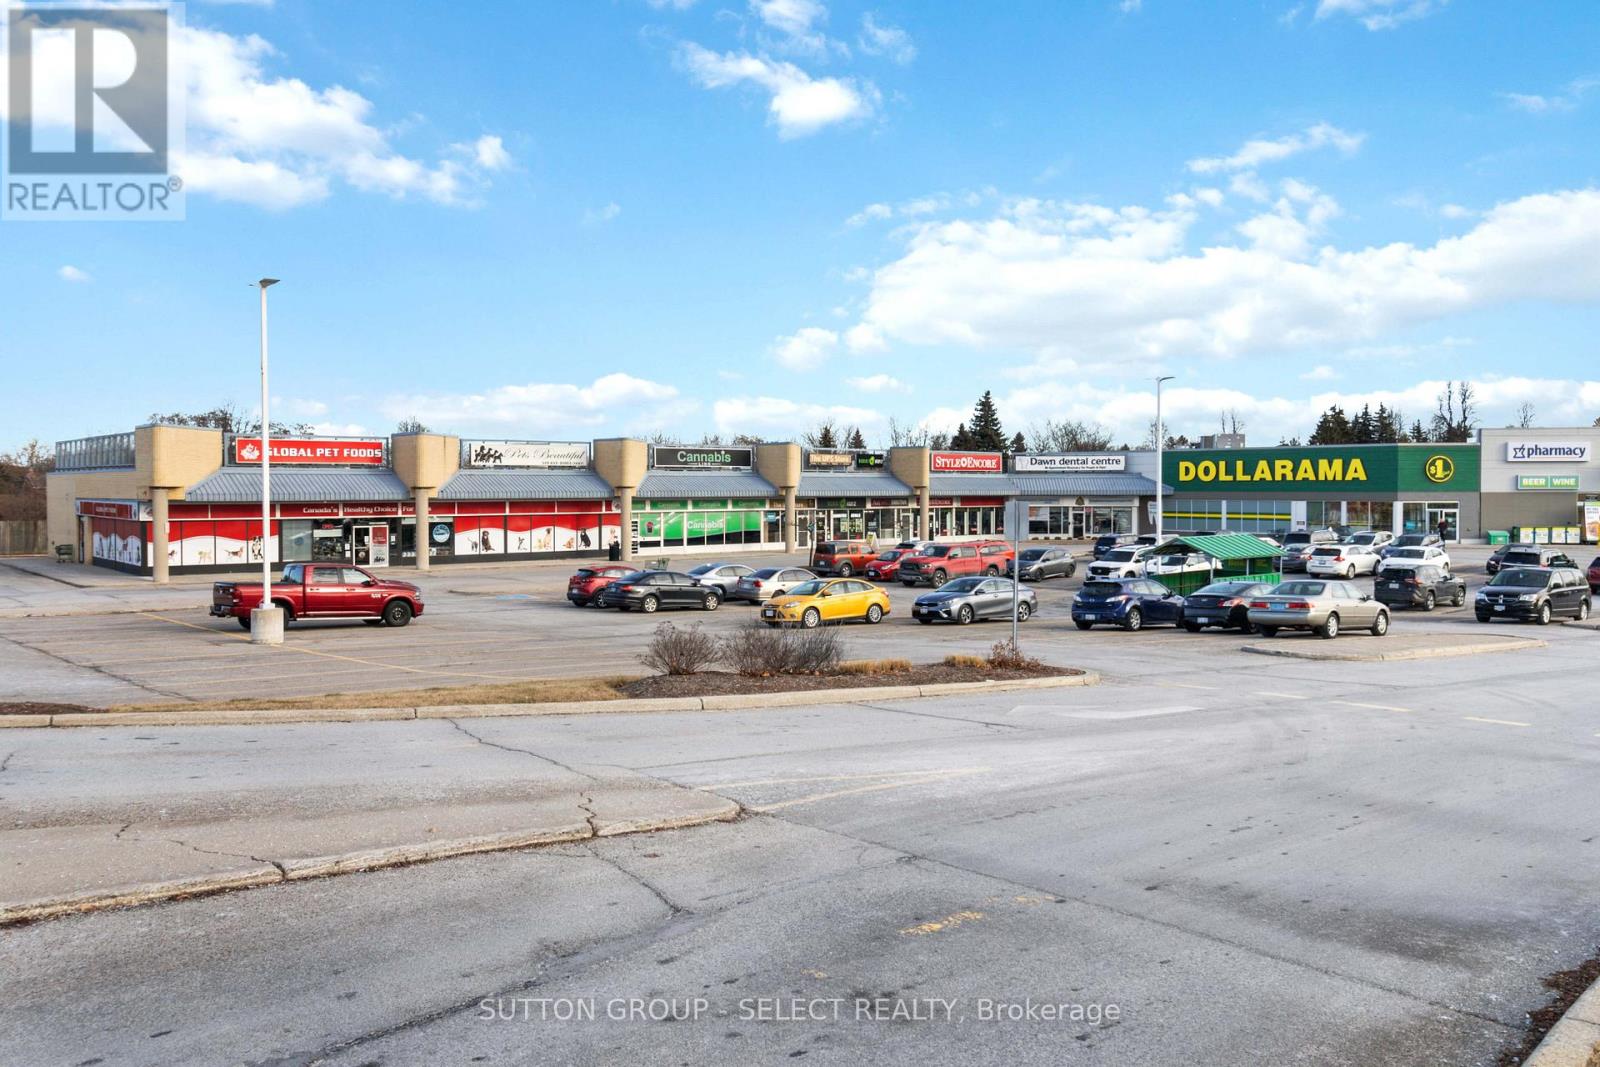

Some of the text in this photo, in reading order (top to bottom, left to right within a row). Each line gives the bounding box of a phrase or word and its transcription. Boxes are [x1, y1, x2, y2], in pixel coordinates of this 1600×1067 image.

[316, 448, 339, 458] PET
[344, 448, 382, 458] FOODS
[677, 450, 732, 463] Cannabis
[1527, 444, 1586, 458] pharmacy
[1030, 457, 1121, 466] Dawn dental centre
[1178, 458, 1368, 482] DOLLARAMA
[1522, 478, 1577, 487] BEER WINE
